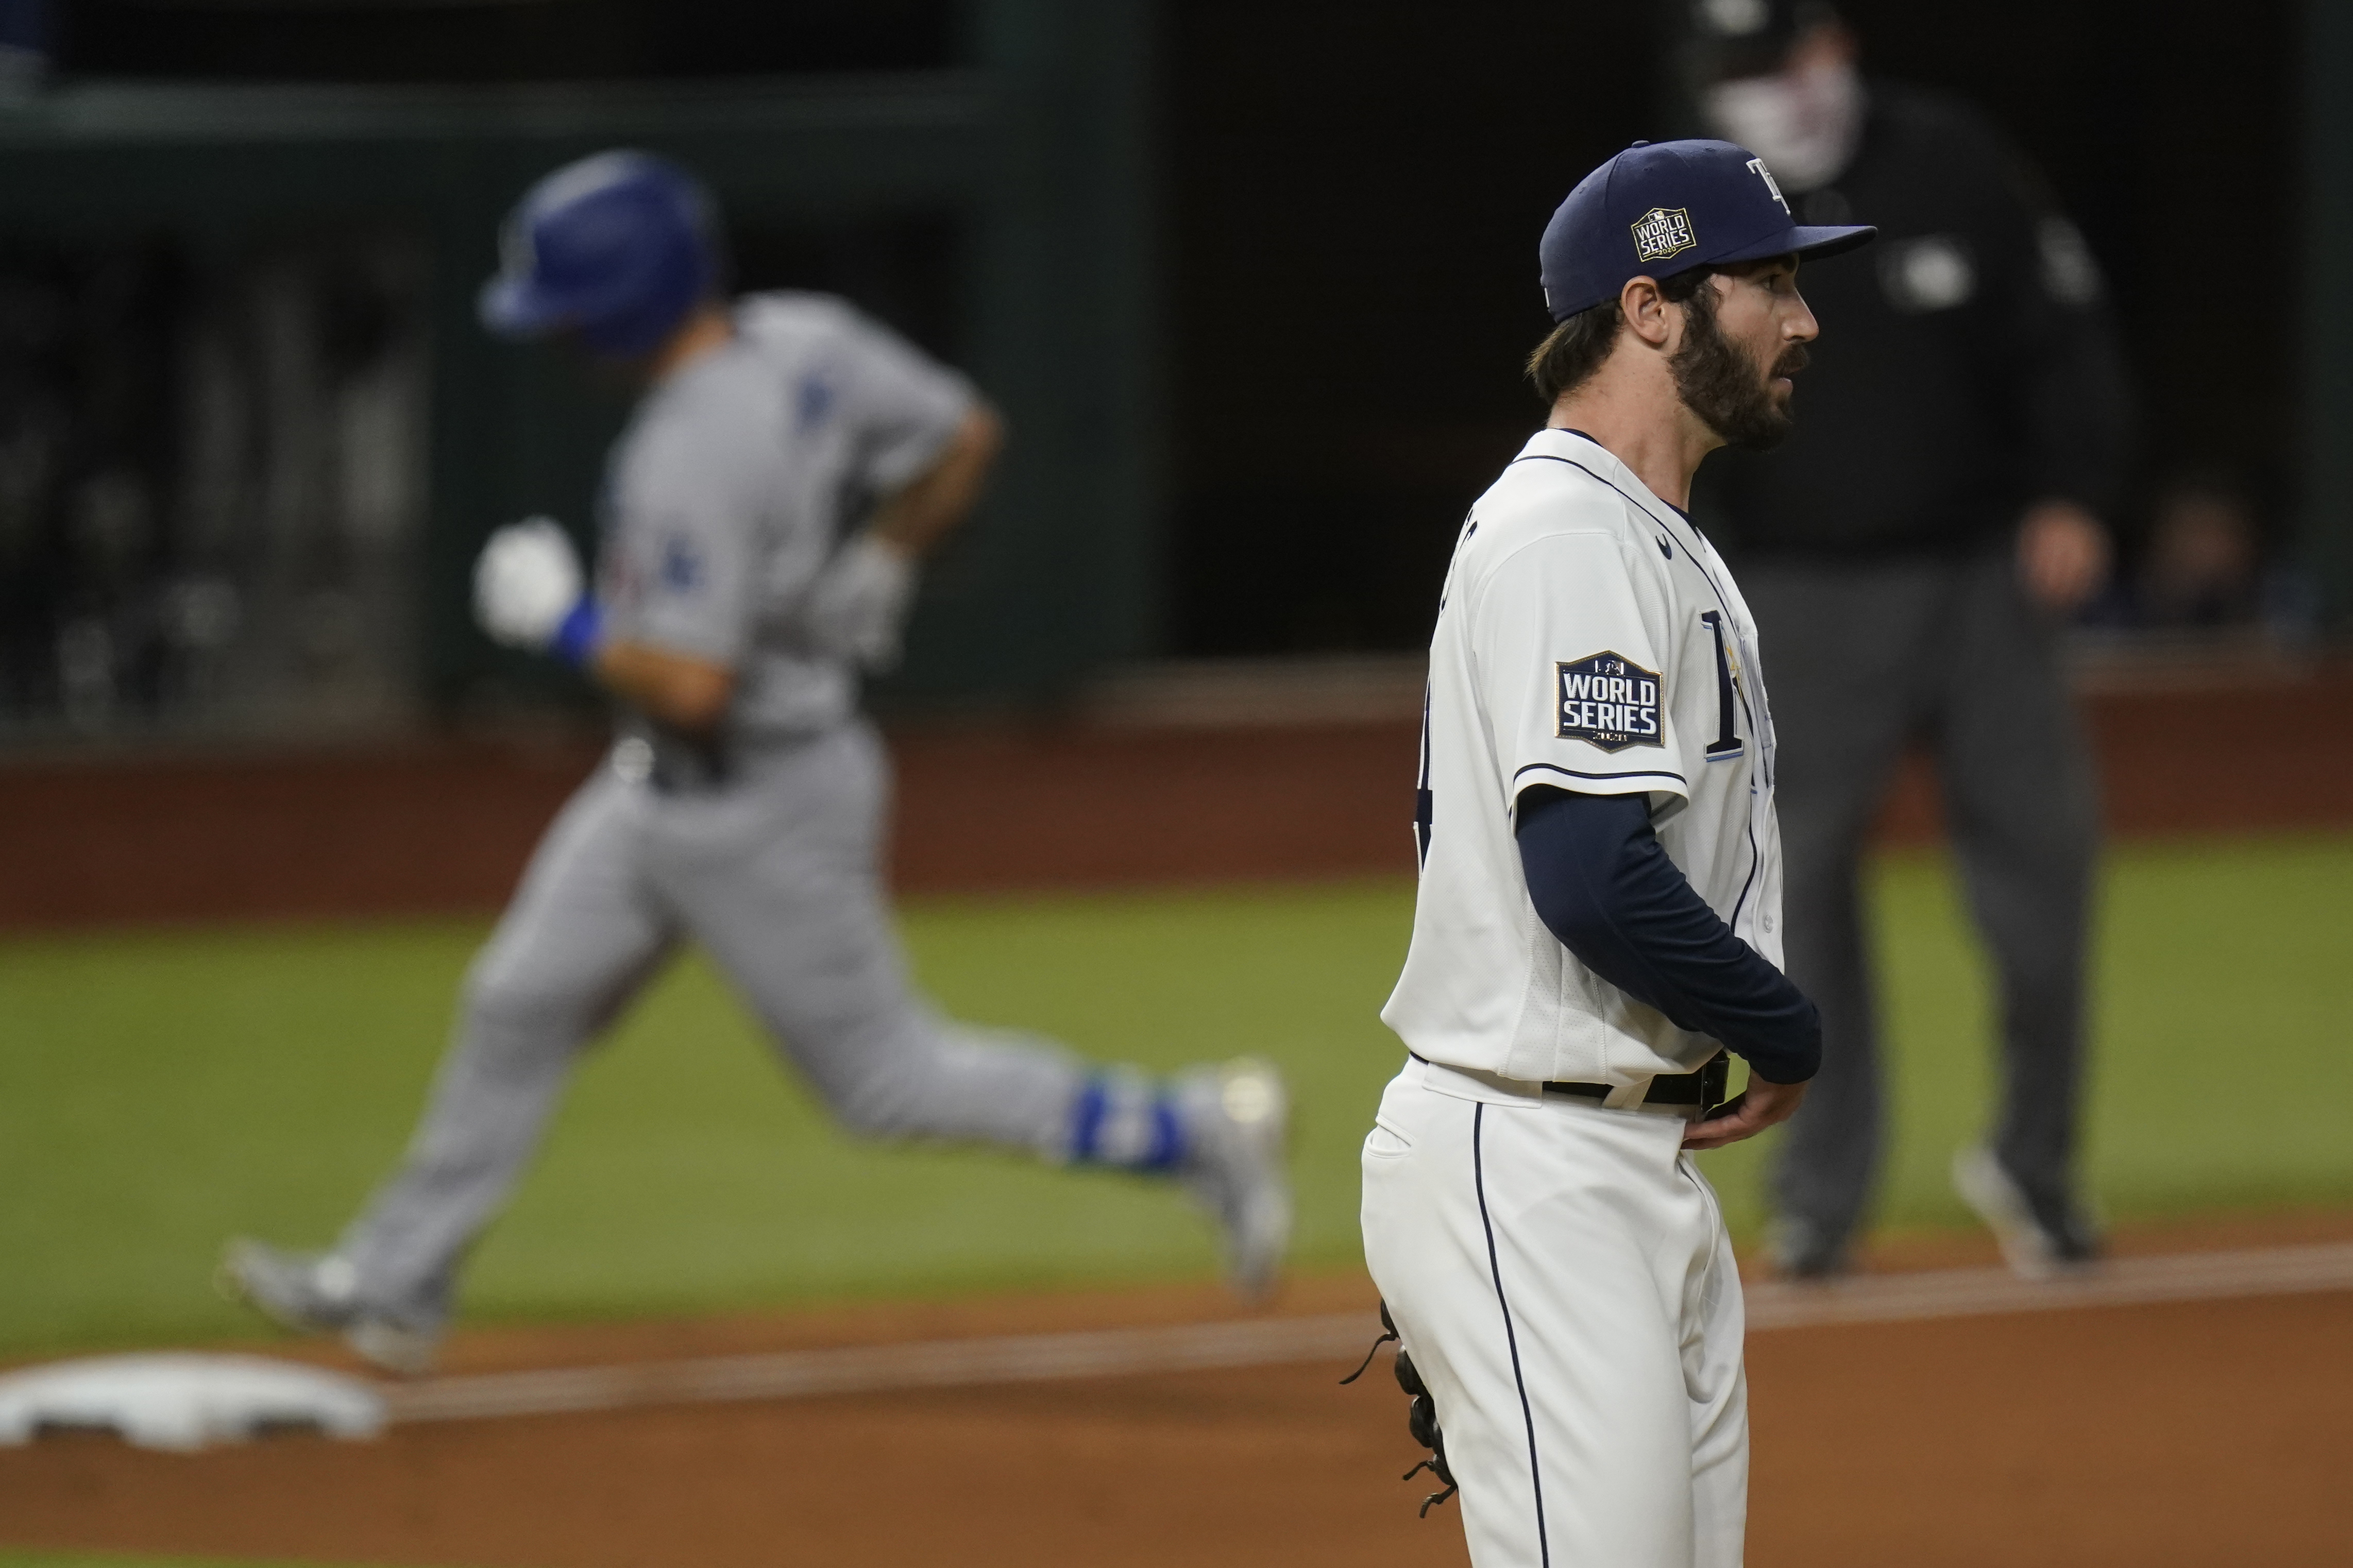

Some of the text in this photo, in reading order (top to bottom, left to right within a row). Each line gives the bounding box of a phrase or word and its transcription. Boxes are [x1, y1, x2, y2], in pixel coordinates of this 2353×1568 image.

[1636, 215, 1686, 241] WORLD
[1640, 228, 1690, 255] SERIES
[1658, 246, 1677, 255] 2020
[1563, 673, 1656, 707] WORLD
[1563, 700, 1657, 735] SERIES
